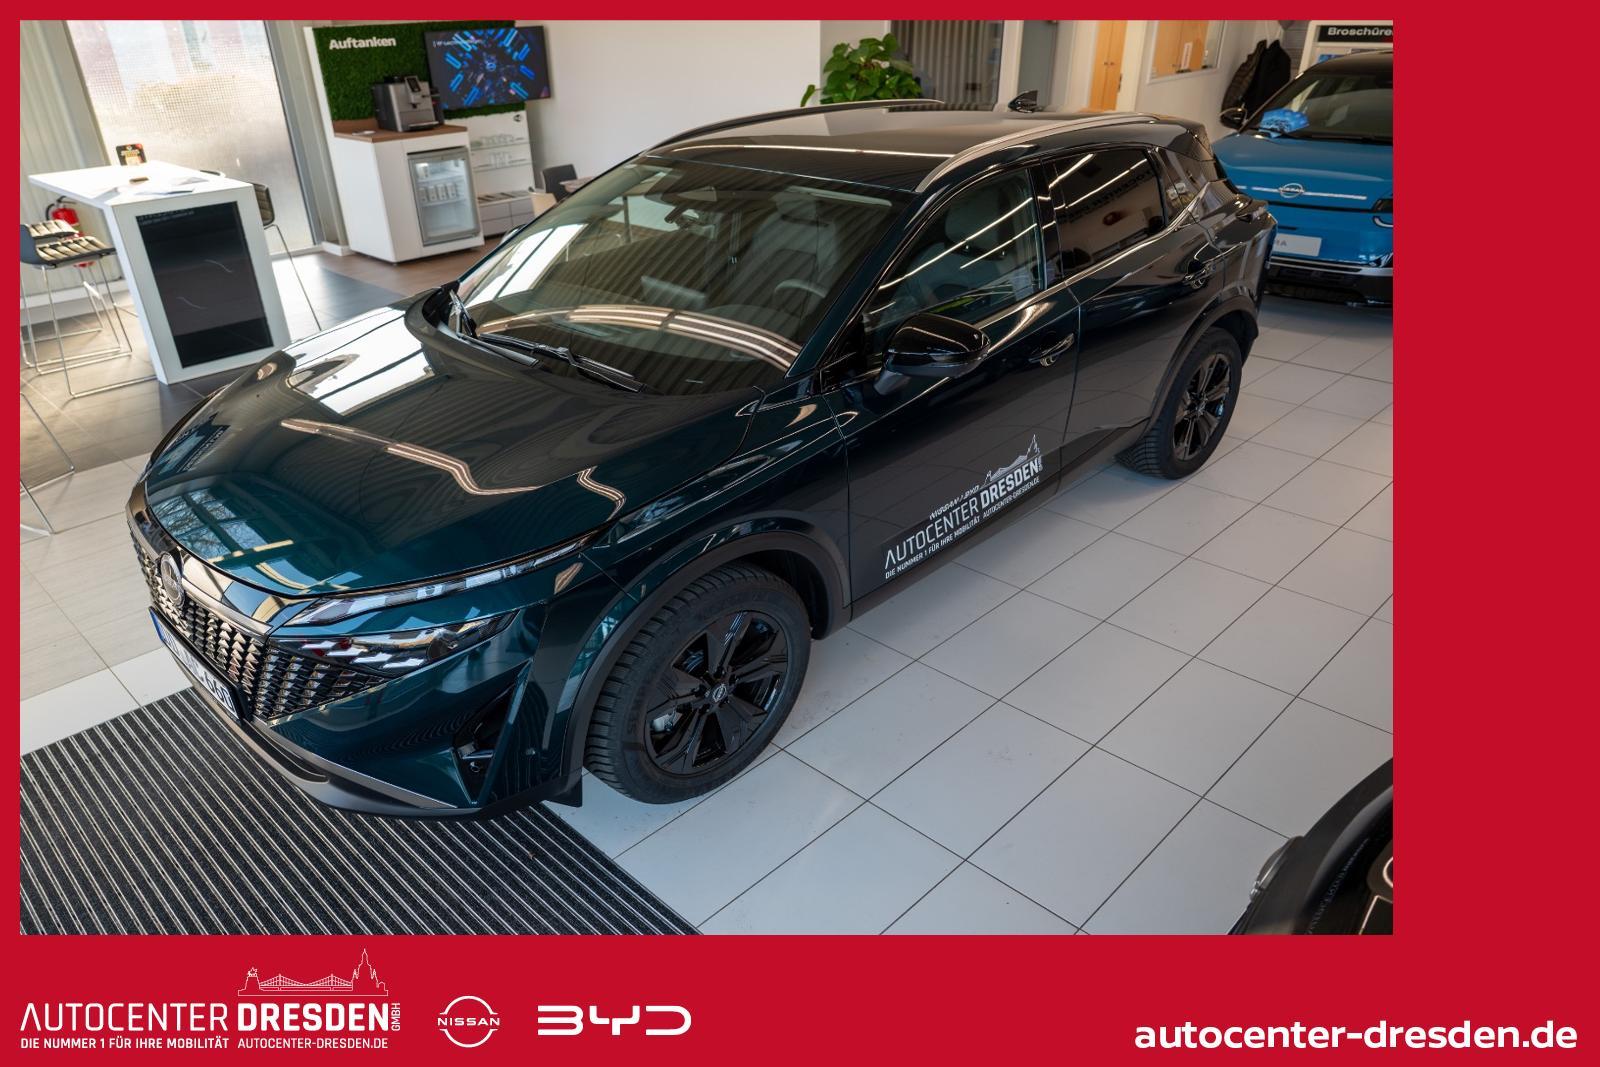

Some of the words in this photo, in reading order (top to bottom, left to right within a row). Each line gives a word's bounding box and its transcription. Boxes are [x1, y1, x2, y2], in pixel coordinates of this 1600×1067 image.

[329, 36, 397, 50] Auftanken
[1328, 27, 1393, 36] Broschüre
[885, 497, 979, 570] AUTOCENTER
[980, 457, 1039, 509] DRESDEN
[885, 567, 896, 579] DIE
[896, 552, 924, 573] NUMMER
[928, 542, 940, 554] FÜR
[940, 533, 954, 546] IHRE
[954, 515, 980, 538] MOBILITÄT
